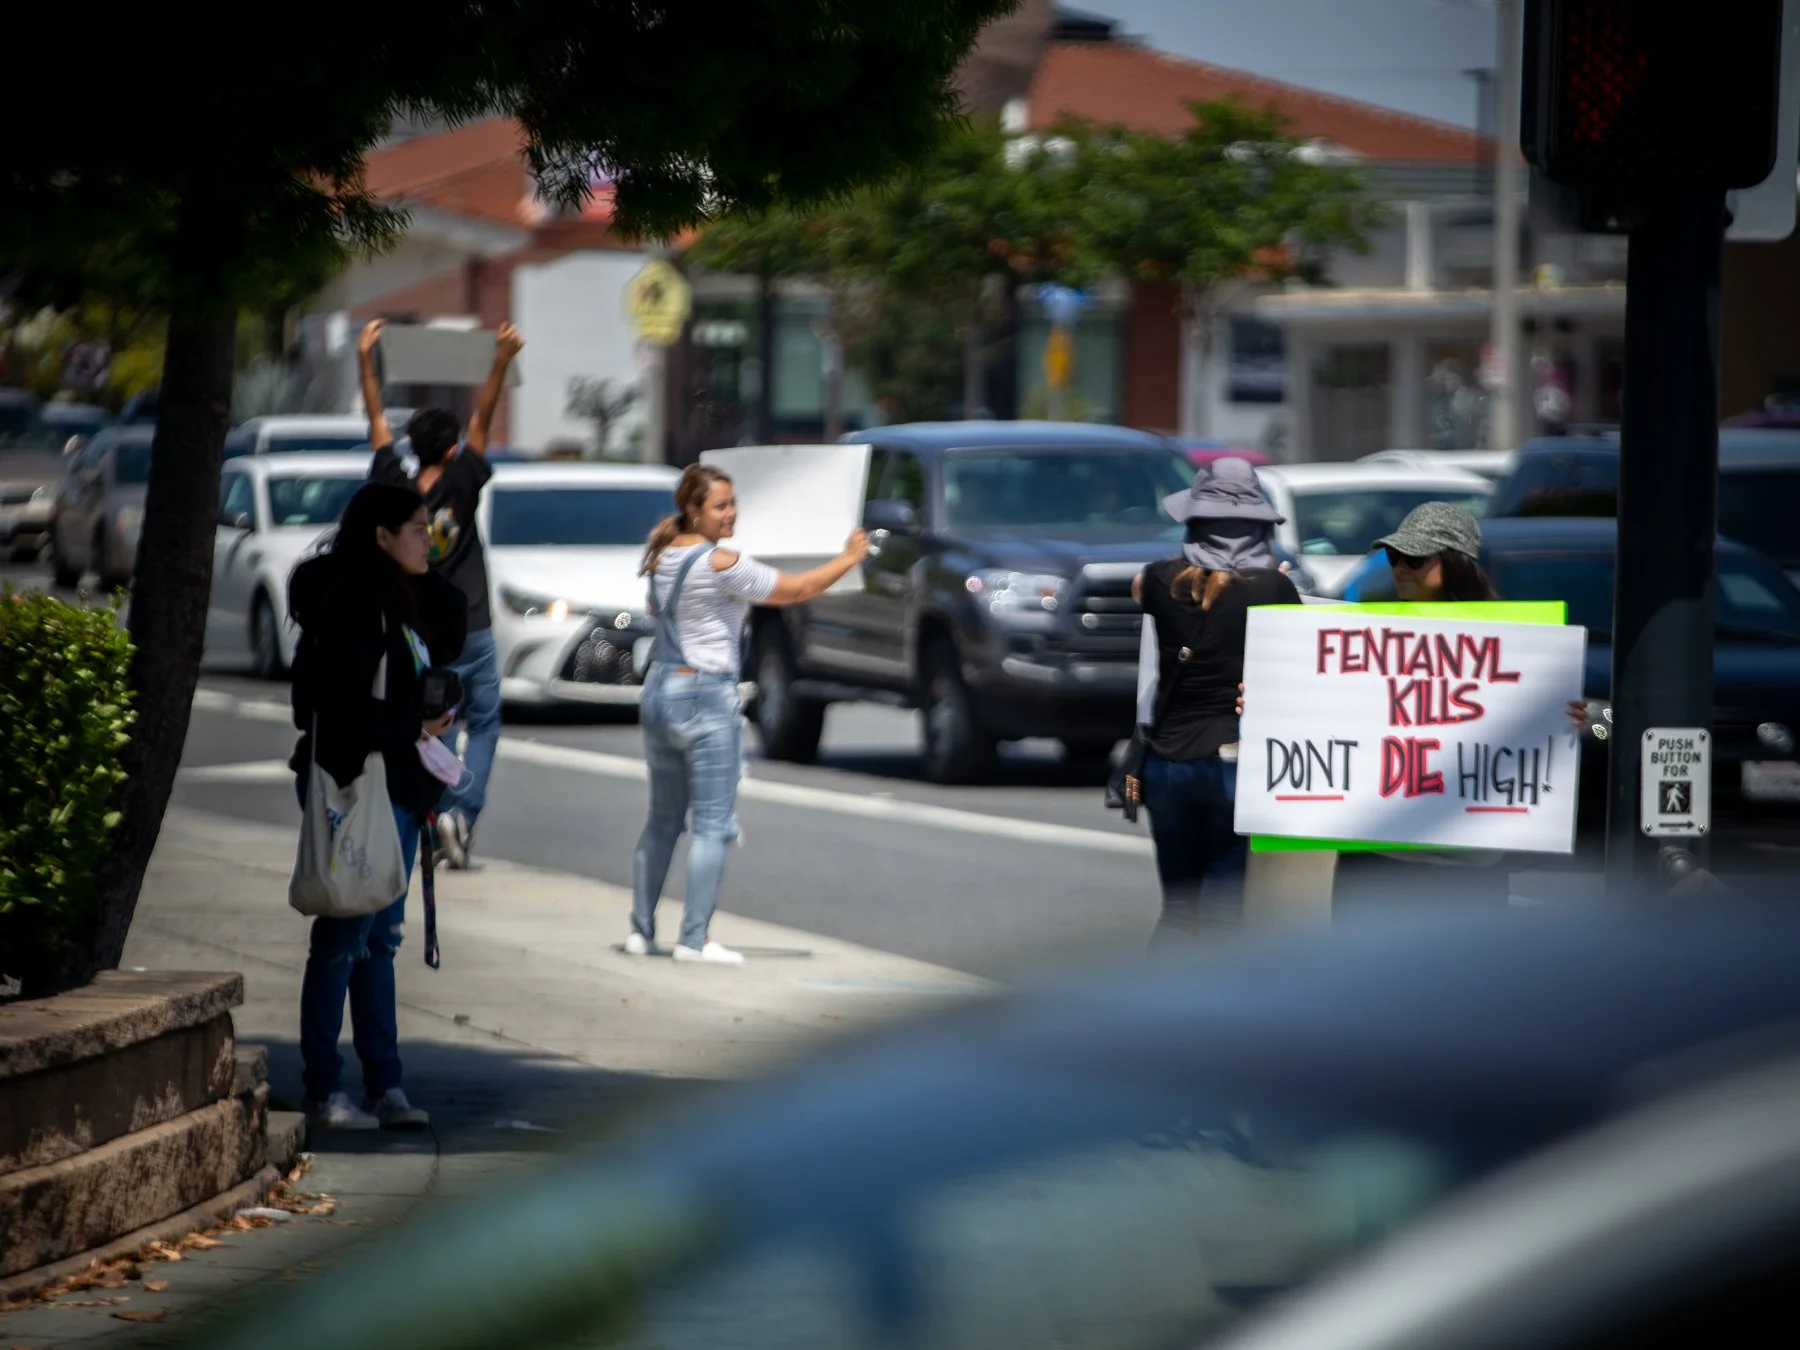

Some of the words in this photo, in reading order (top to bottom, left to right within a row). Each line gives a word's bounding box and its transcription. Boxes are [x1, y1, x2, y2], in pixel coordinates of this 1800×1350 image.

[1317, 626, 1520, 683] FENTANYL
[1387, 676, 1484, 727] KILLS
[1650, 751, 1702, 764] BUTTON
[1658, 738, 1694, 750] PUSH
[1379, 735, 1445, 798] DIE
[1457, 734, 1552, 805] HIGH!
[1663, 764, 1689, 777] FOR
